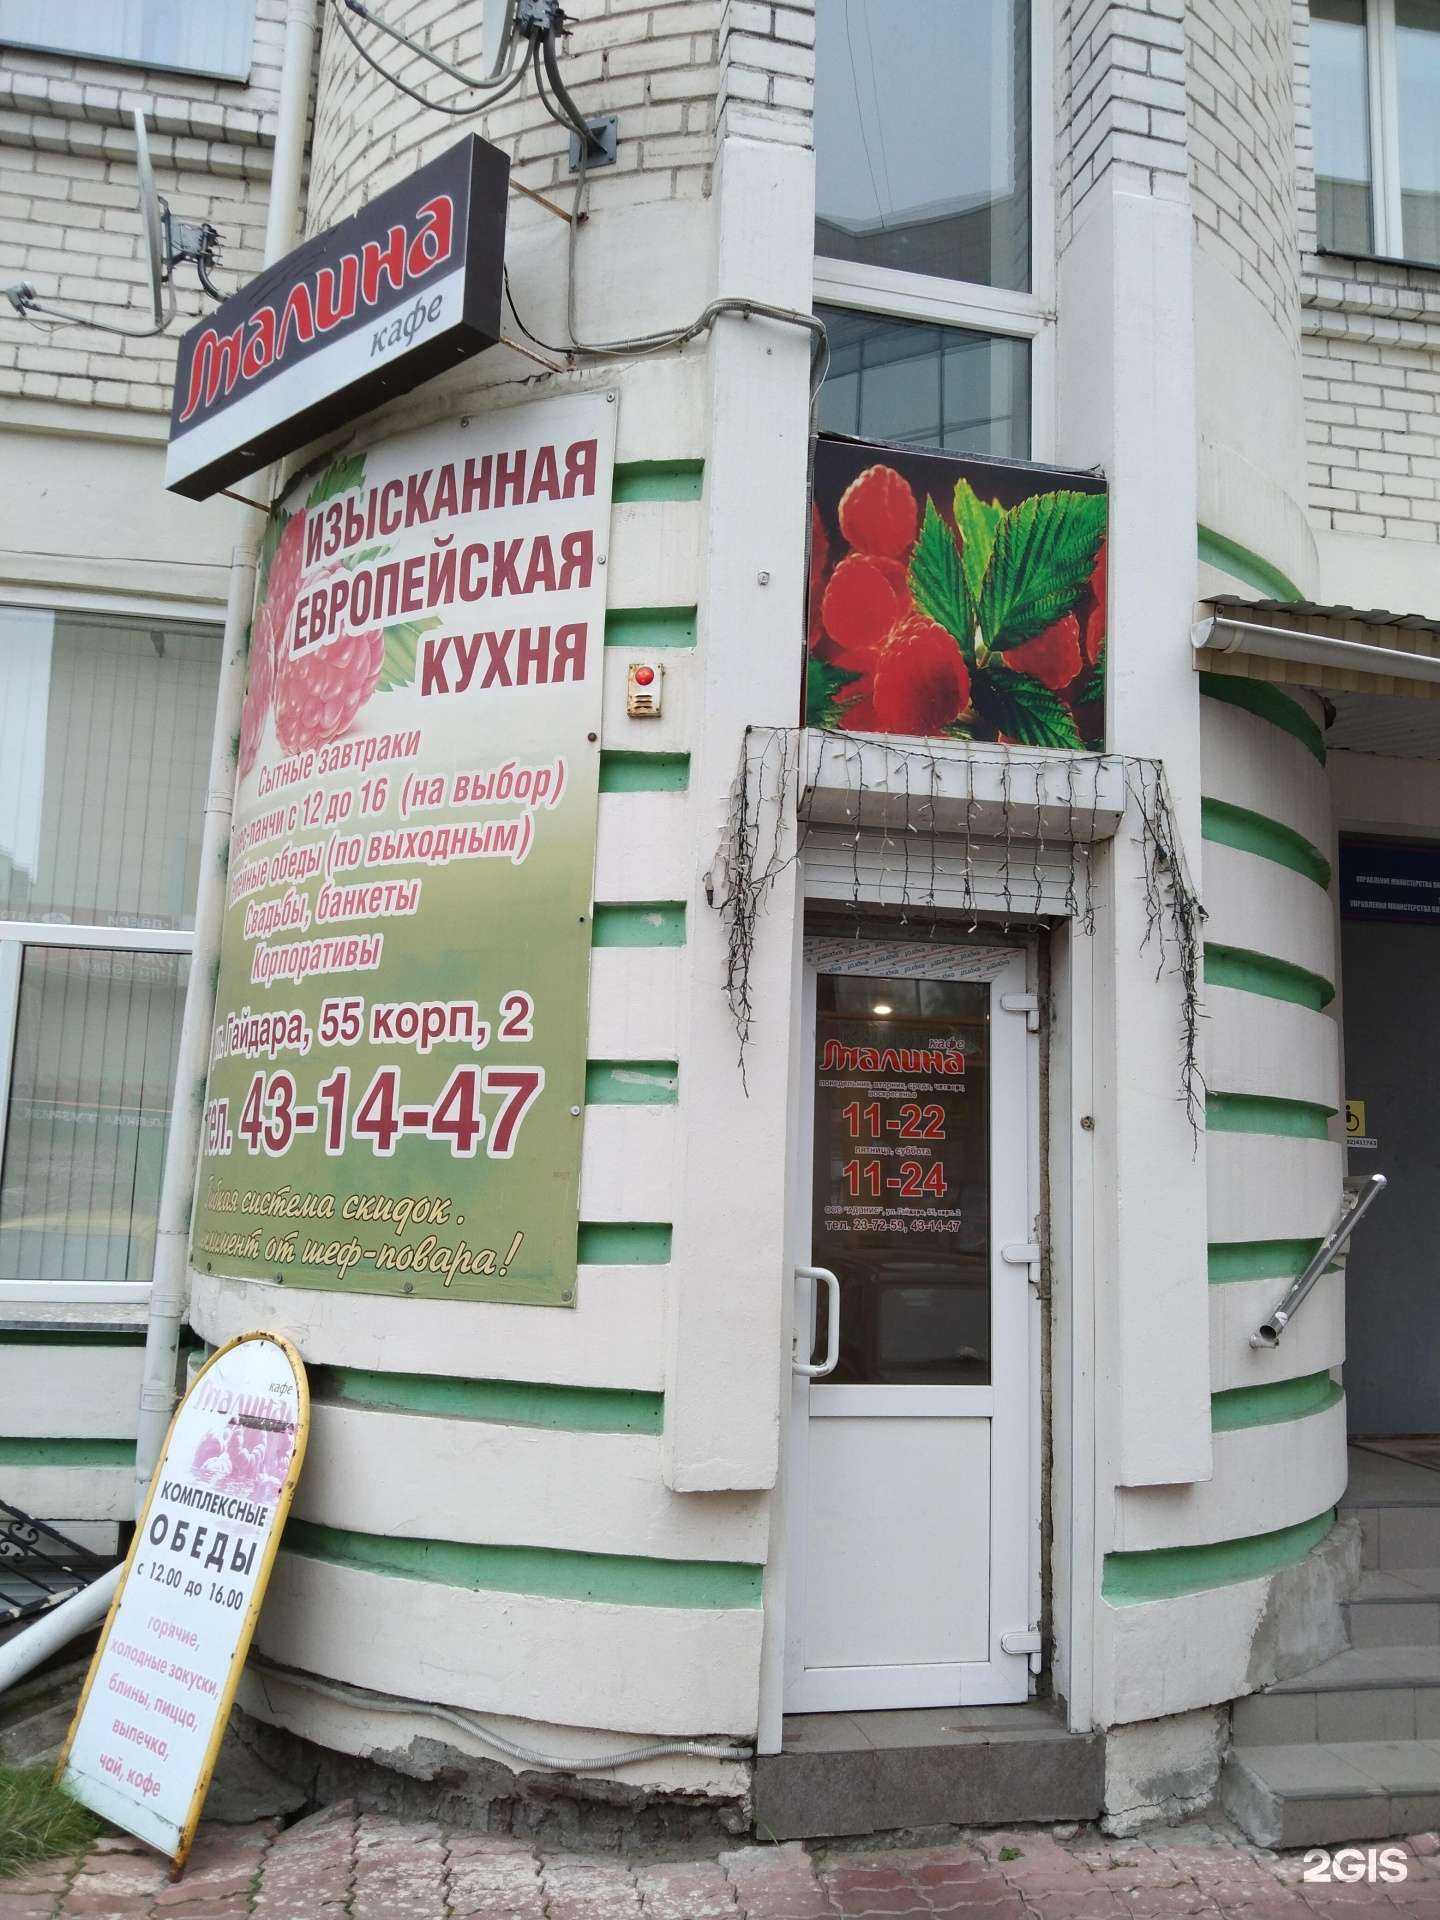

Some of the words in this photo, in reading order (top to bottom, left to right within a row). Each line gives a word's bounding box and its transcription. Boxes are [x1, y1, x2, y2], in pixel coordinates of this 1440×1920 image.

[370, 293, 443, 357] кафе
[304, 438, 599, 569] ИЗЫСКАННАЯ
[293, 529, 594, 652] ЕВРОПЕЙСКАЯ
[421, 622, 589, 697] КУХНЯ
[257, 752, 313, 798] Сытные
[317, 730, 421, 773] завтраки
[287, 805, 297, 831] с
[303, 791, 321, 826] 12
[325, 790, 351, 824] до
[361, 778, 388, 815] 16
[402, 772, 443, 816] (на
[452, 759, 565, 807] выбор)
[271, 845, 321, 880] обеды
[327, 834, 362, 877] (по
[367, 813, 531, 864] выходным)
[245, 895, 311, 937] Свадьбы,
[317, 882, 419, 921] банкеты
[253, 938, 382, 986] Корпоративы
[226, 1011, 310, 1055] Гайдара,
[321, 1001, 361, 1041] 55
[373, 1005, 487, 1048] корп,
[502, 996, 530, 1037] 2
[928, 1037, 965, 1050] кафе
[819, 1039, 965, 1075] Малина
[240, 1070, 540, 1152] 43-14-47
[843, 1102, 946, 1140] 11-22
[241, 1184, 335, 1219] система
[843, 1160, 947, 1198] 11-24
[825, 1220, 851, 1231] тел.
[910, 1220, 961, 1232] 43-14-47
[264, 1231, 299, 1264] от
[301, 1232, 525, 1288] шеф-повара!
[268, 1382, 294, 1396] кафе
[160, 1480, 270, 1528] КОМПЛЕКСНЫЕ
[149, 1513, 258, 1576] ОБЕДЫ
[137, 1562, 145, 1576] с
[149, 1561, 183, 1589] 12.00
[184, 1580, 203, 1597] до
[209, 1582, 244, 1611] 16.00
[147, 1616, 201, 1652] горячие,
[111, 1637, 168, 1675] холодные
[168, 1663, 220, 1700] закуски,
[108, 1672, 152, 1712] блины,
[153, 1696, 199, 1733] пицца,
[111, 1717, 170, 1763] выпечка,
[99, 1752, 125, 1783] чай,
[126, 1771, 162, 1799] кофе
